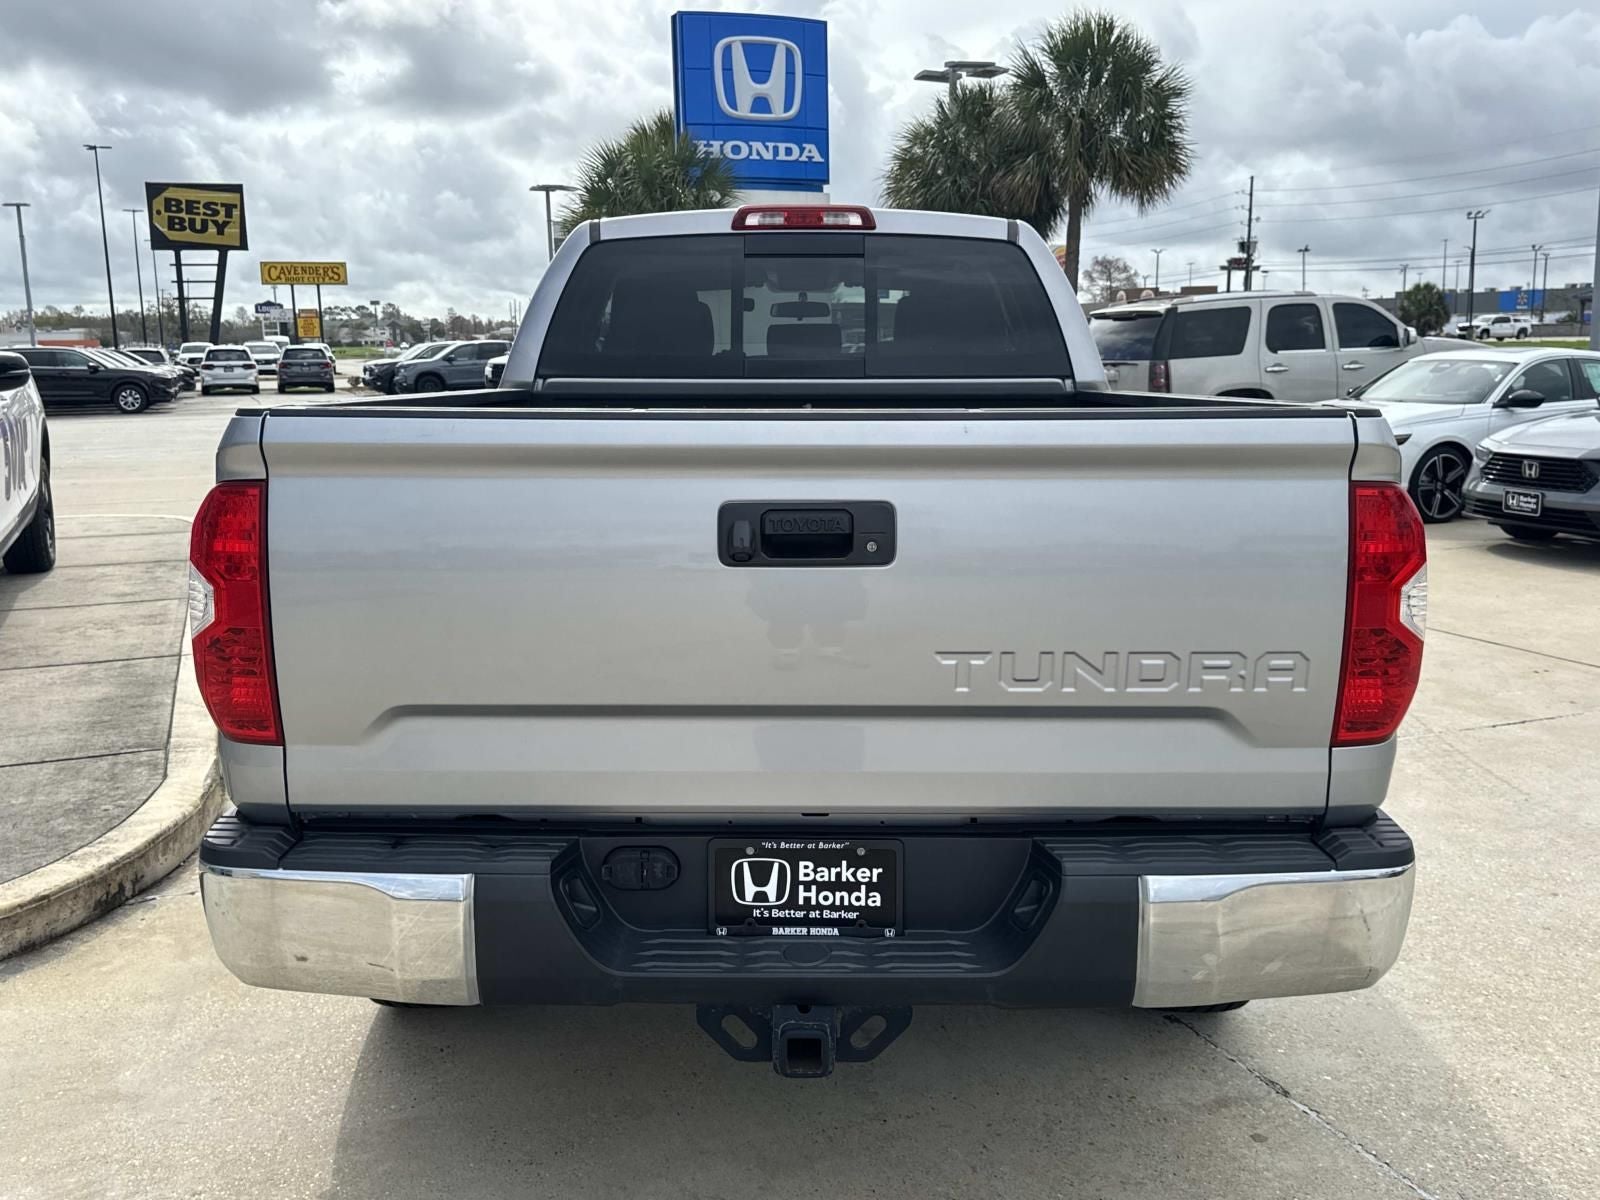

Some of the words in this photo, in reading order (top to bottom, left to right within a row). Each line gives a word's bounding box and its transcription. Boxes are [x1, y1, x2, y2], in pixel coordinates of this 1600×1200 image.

[693, 139, 825, 163] HONDA
[163, 197, 238, 219] BEST
[167, 215, 232, 236] BUY
[267, 264, 341, 282] CAVENDER'S
[768, 517, 845, 533] TOYOTA
[934, 651, 1311, 692] TUNDRA
[780, 841, 804, 849] Better
[798, 860, 883, 883] Barker
[798, 884, 882, 907] Honda
[753, 907, 769, 918] It's
[771, 908, 807, 918] Better
[809, 909, 820, 919] at
[822, 909, 860, 919] Barker
[771, 927, 808, 936] BARKER
[809, 927, 840, 936] HONDA
